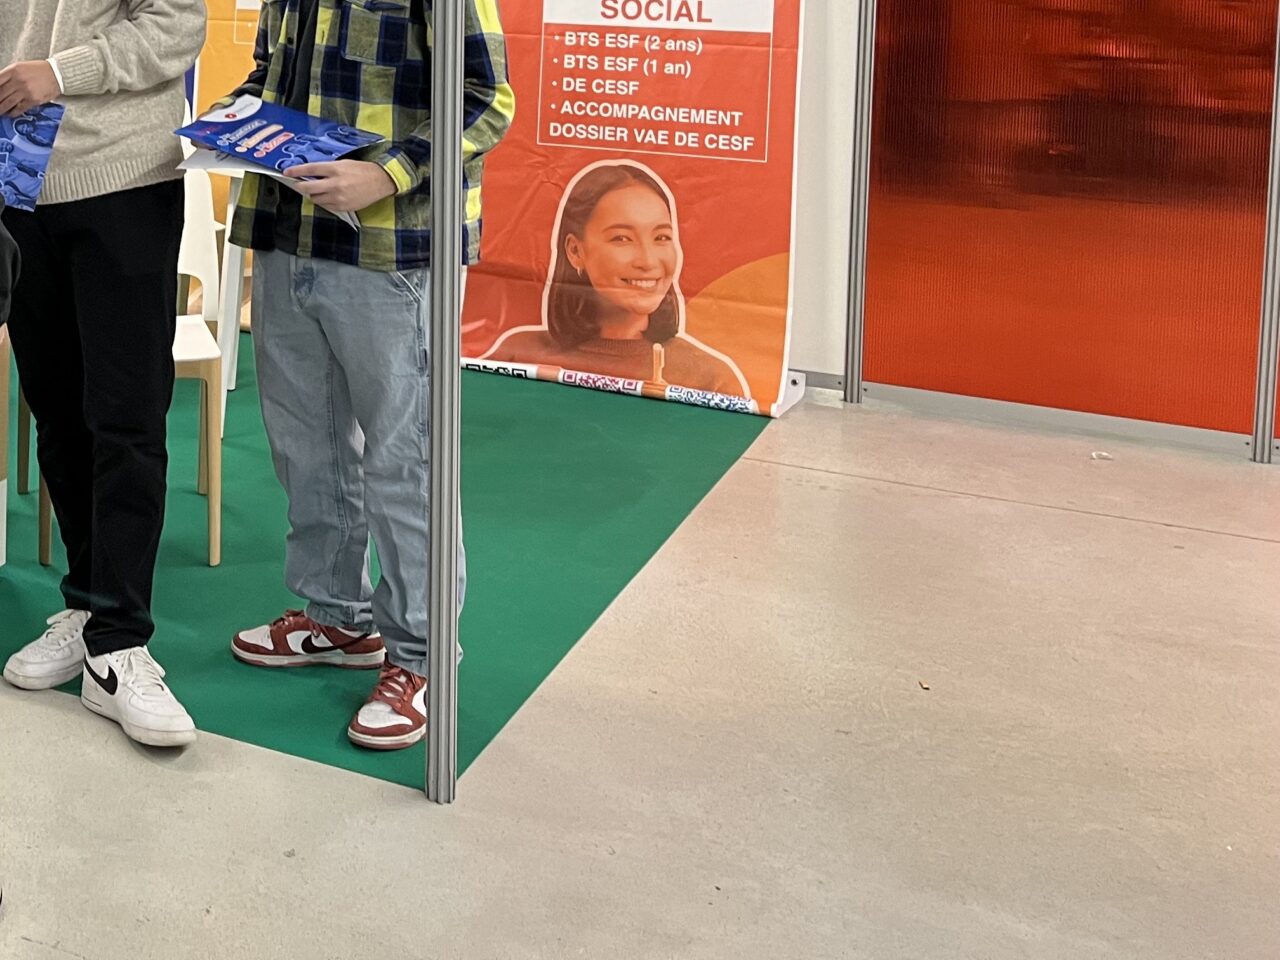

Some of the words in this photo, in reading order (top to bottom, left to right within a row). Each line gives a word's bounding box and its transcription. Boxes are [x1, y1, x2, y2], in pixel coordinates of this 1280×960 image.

[564, 31, 600, 47] BTS
[604, 33, 640, 49] ESF
[644, 35, 661, 54] (2
[666, 37, 703, 55] ans)
[563, 54, 599, 70] BTS
[604, 56, 639, 72] ESF
[643, 58, 658, 77] (1
[663, 59, 692, 79] an)
[562, 77, 588, 93] DE
[592, 78, 640, 96] CESF
[560, 100, 743, 127] ACCOMPAGNEMENT
[549, 122, 628, 142] DOSSIER
[633, 128, 669, 145] VAE
[673, 131, 700, 148] DE
[704, 133, 755, 152] CESF
